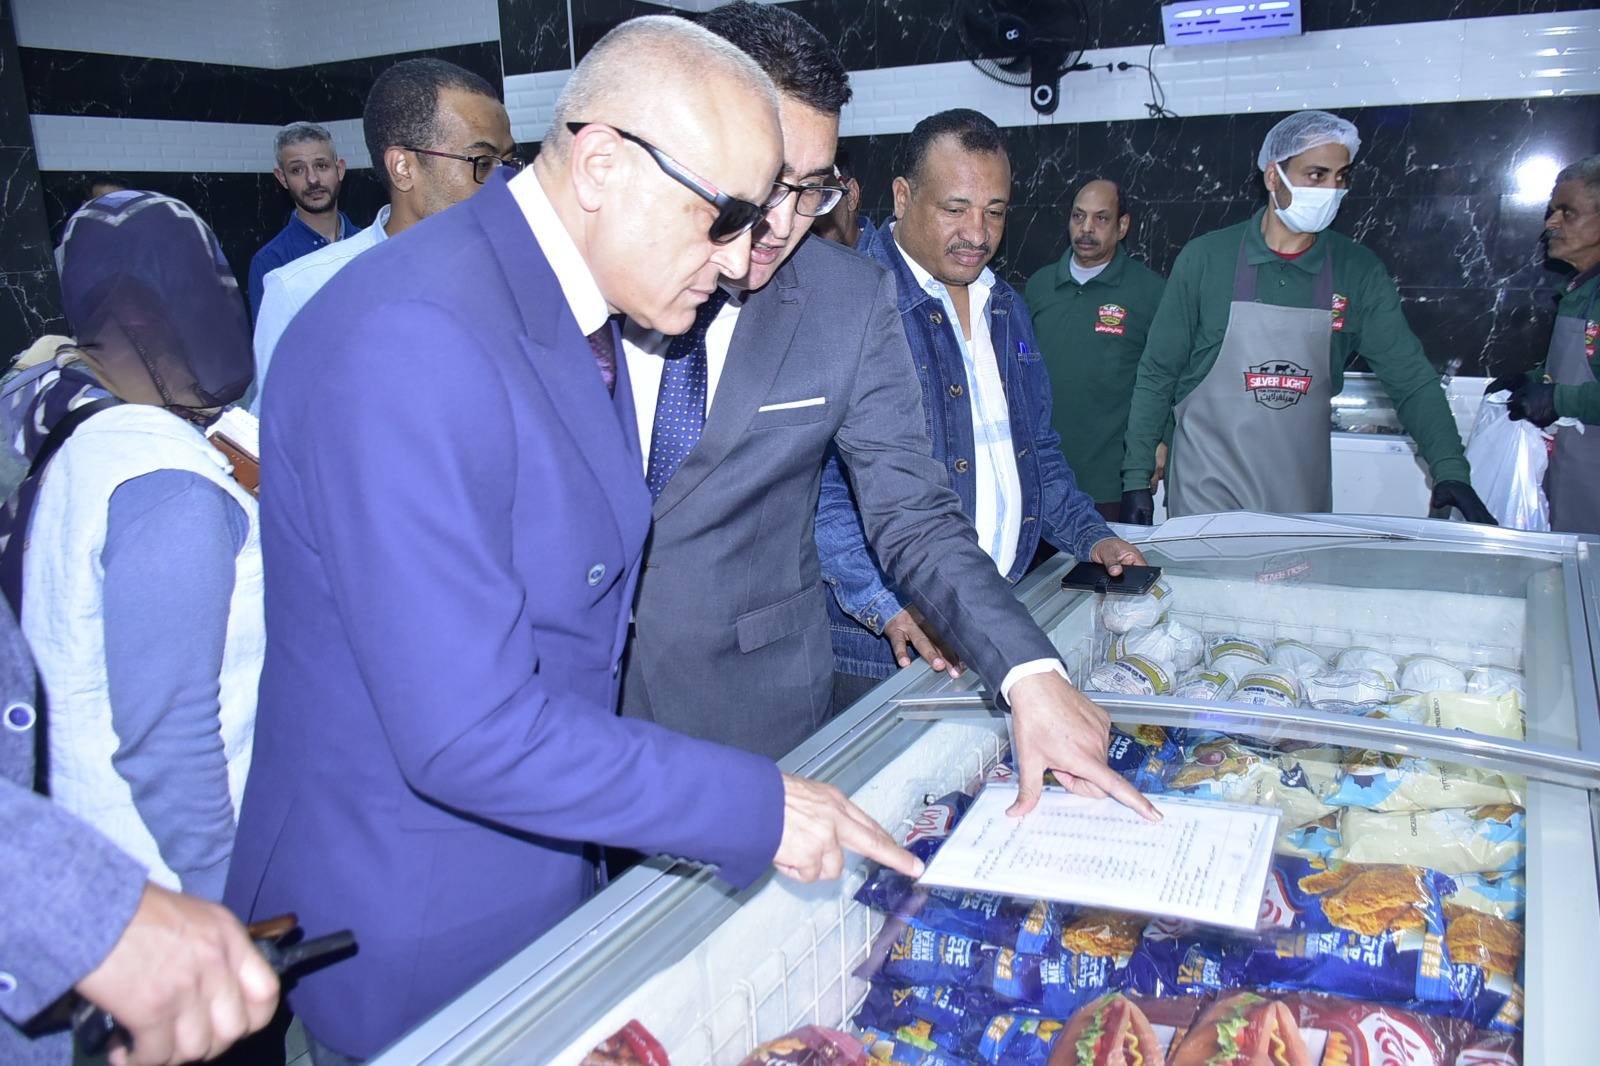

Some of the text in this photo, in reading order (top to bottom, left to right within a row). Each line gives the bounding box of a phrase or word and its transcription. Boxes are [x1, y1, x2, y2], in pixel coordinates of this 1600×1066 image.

[1250, 376, 1307, 390] SILVER LIGHT
[922, 931, 930, 960] MEA
[1177, 964, 1192, 984] 12
